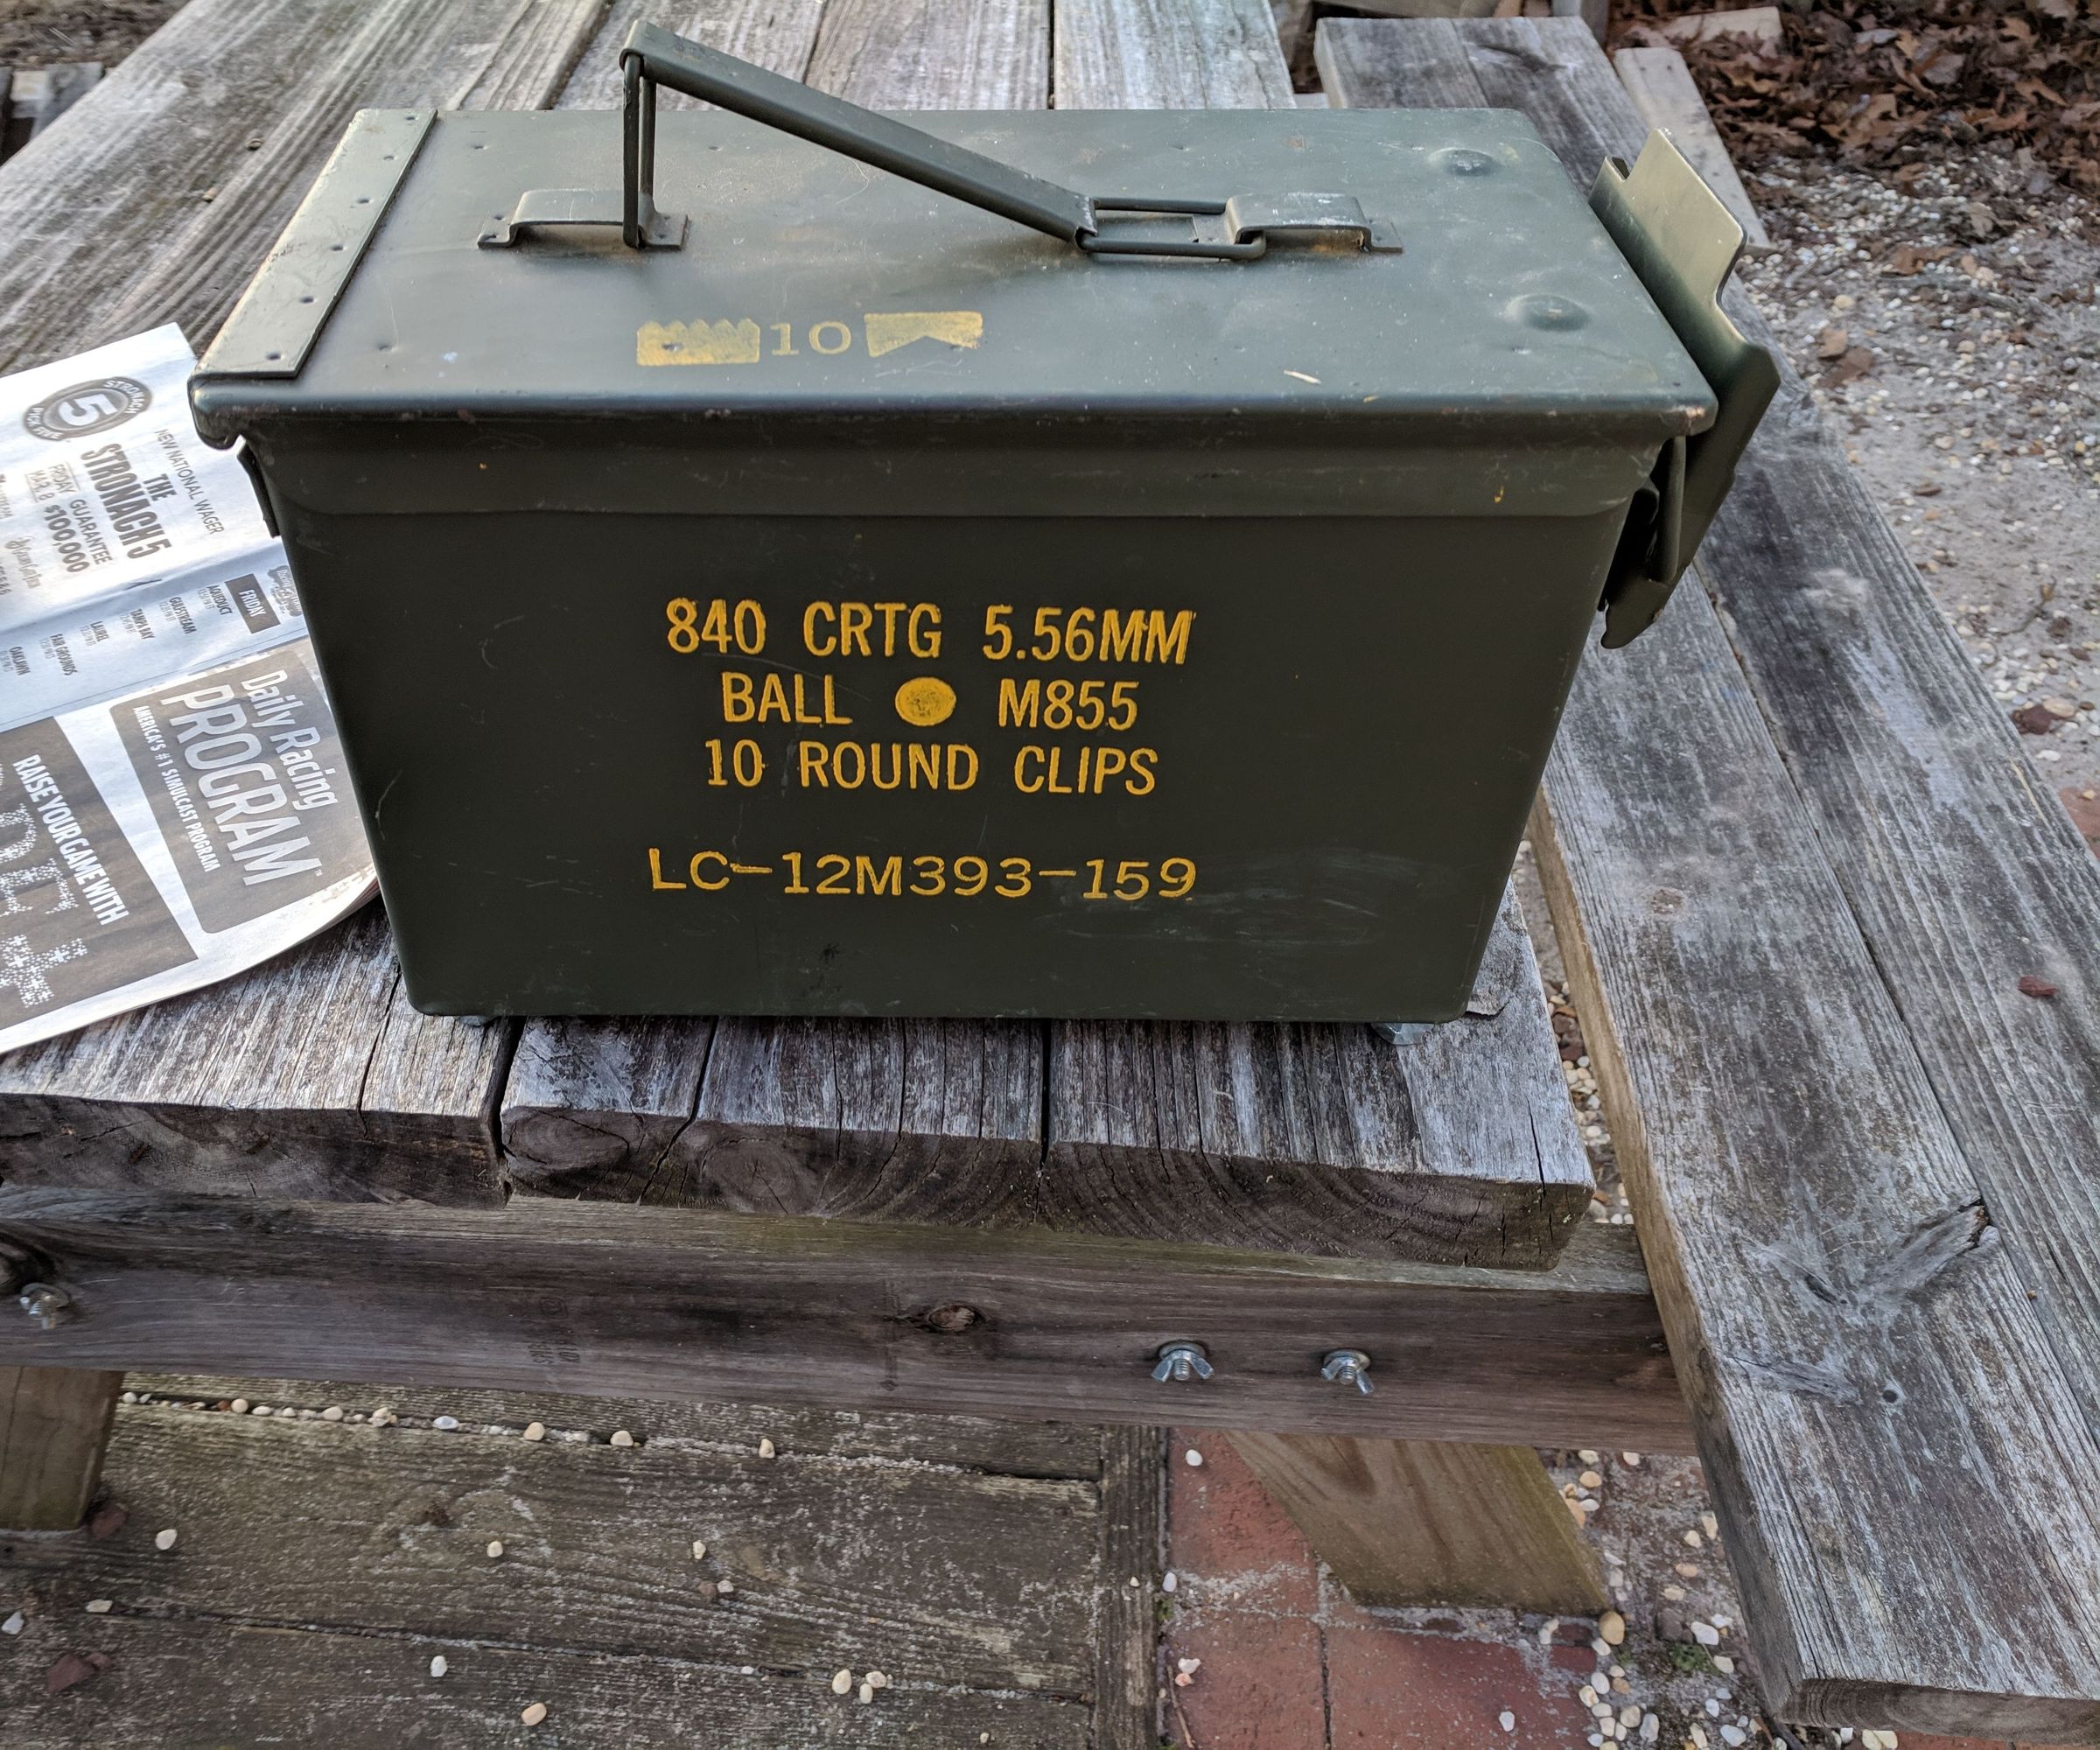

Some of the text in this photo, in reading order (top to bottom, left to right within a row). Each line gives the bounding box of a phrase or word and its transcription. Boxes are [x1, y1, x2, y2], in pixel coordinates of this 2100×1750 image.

[770, 321, 851, 355] 10
[59, 394, 118, 426] 5
[103, 380, 145, 414] STRONACH
[38, 492, 55, 501] 8
[48, 464, 77, 494] FRIDAY
[80, 443, 172, 559] STRONACH 5
[143, 473, 177, 502] THE
[154, 429, 225, 535] NEW NATIONAL WAGER
[44, 504, 90, 573] $100,000
[69, 499, 113, 564] GUARANTEE
[169, 597, 197, 634] GULFSTREAM
[206, 585, 233, 615] AQUEDUCT
[238, 589, 267, 618] FRIDAY
[89, 621, 109, 641] LAUREL
[130, 609, 155, 639] TAMPA BAY
[667, 598, 1196, 664] 840 CRTG 5.56MM
[9, 646, 31, 676] OAKLAWN
[50, 634, 77, 676] FAIR GROUNDS
[721, 671, 1139, 730] BALL M855
[242, 669, 338, 810] Daily Racing
[13, 754, 50, 802] RAISE
[133, 705, 221, 872] AMERICA'S #1 SIMULCAST PROGRAM
[161, 684, 323, 886] PROGRAM
[705, 738, 1158, 795] 10 ROUND CLIPS
[38, 798, 77, 843] YOUR
[57, 839, 101, 885] GAME
[648, 848, 1196, 901] LC-12M393-159
[82, 878, 130, 926] WITH
